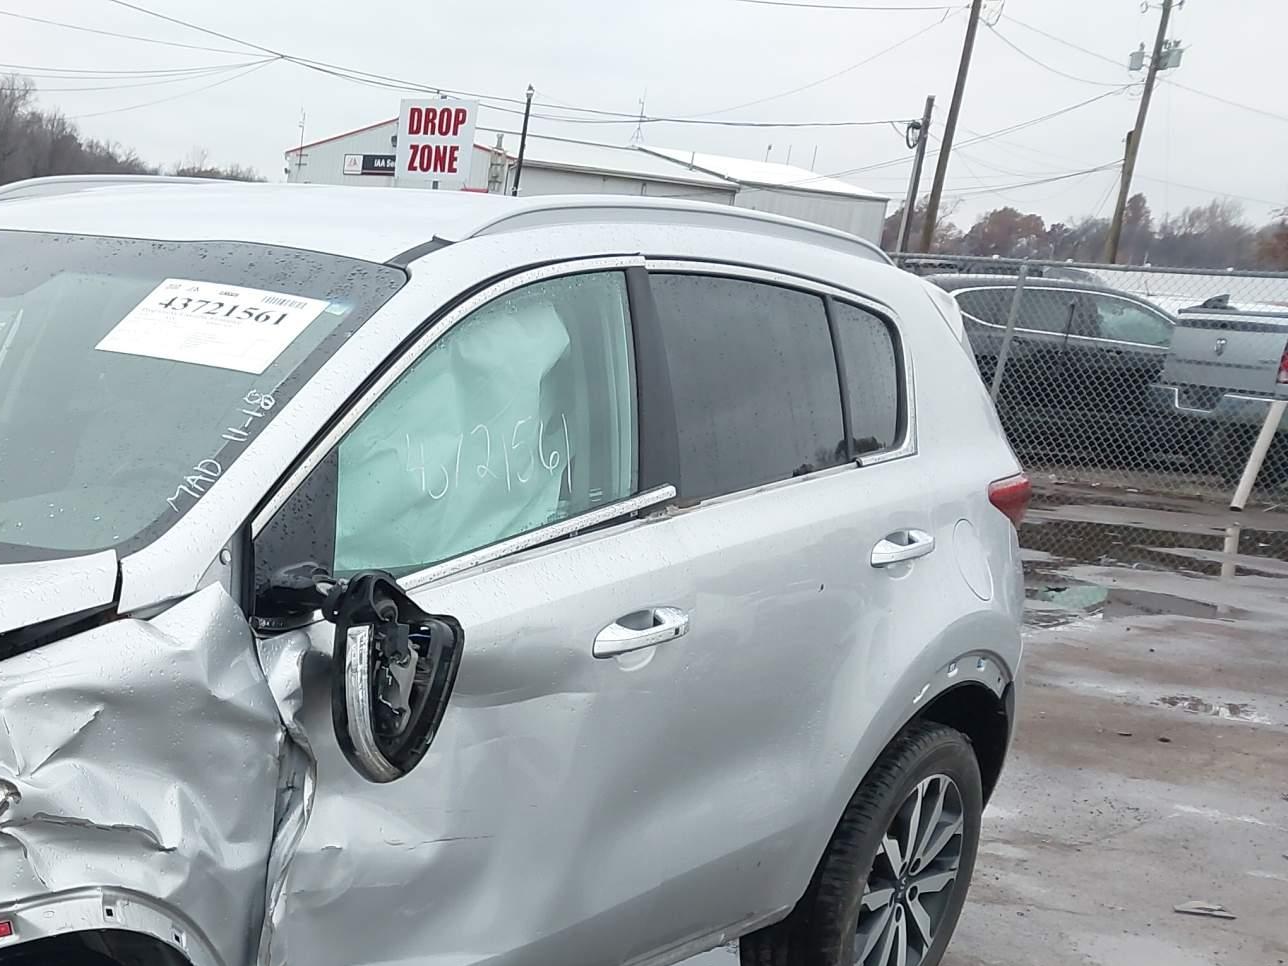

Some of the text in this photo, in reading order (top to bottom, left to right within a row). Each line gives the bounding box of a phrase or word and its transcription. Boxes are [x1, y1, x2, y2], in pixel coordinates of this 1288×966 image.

[407, 107, 467, 136] DROP
[407, 144, 459, 173] ZONE
[158, 295, 289, 326] 43721561
